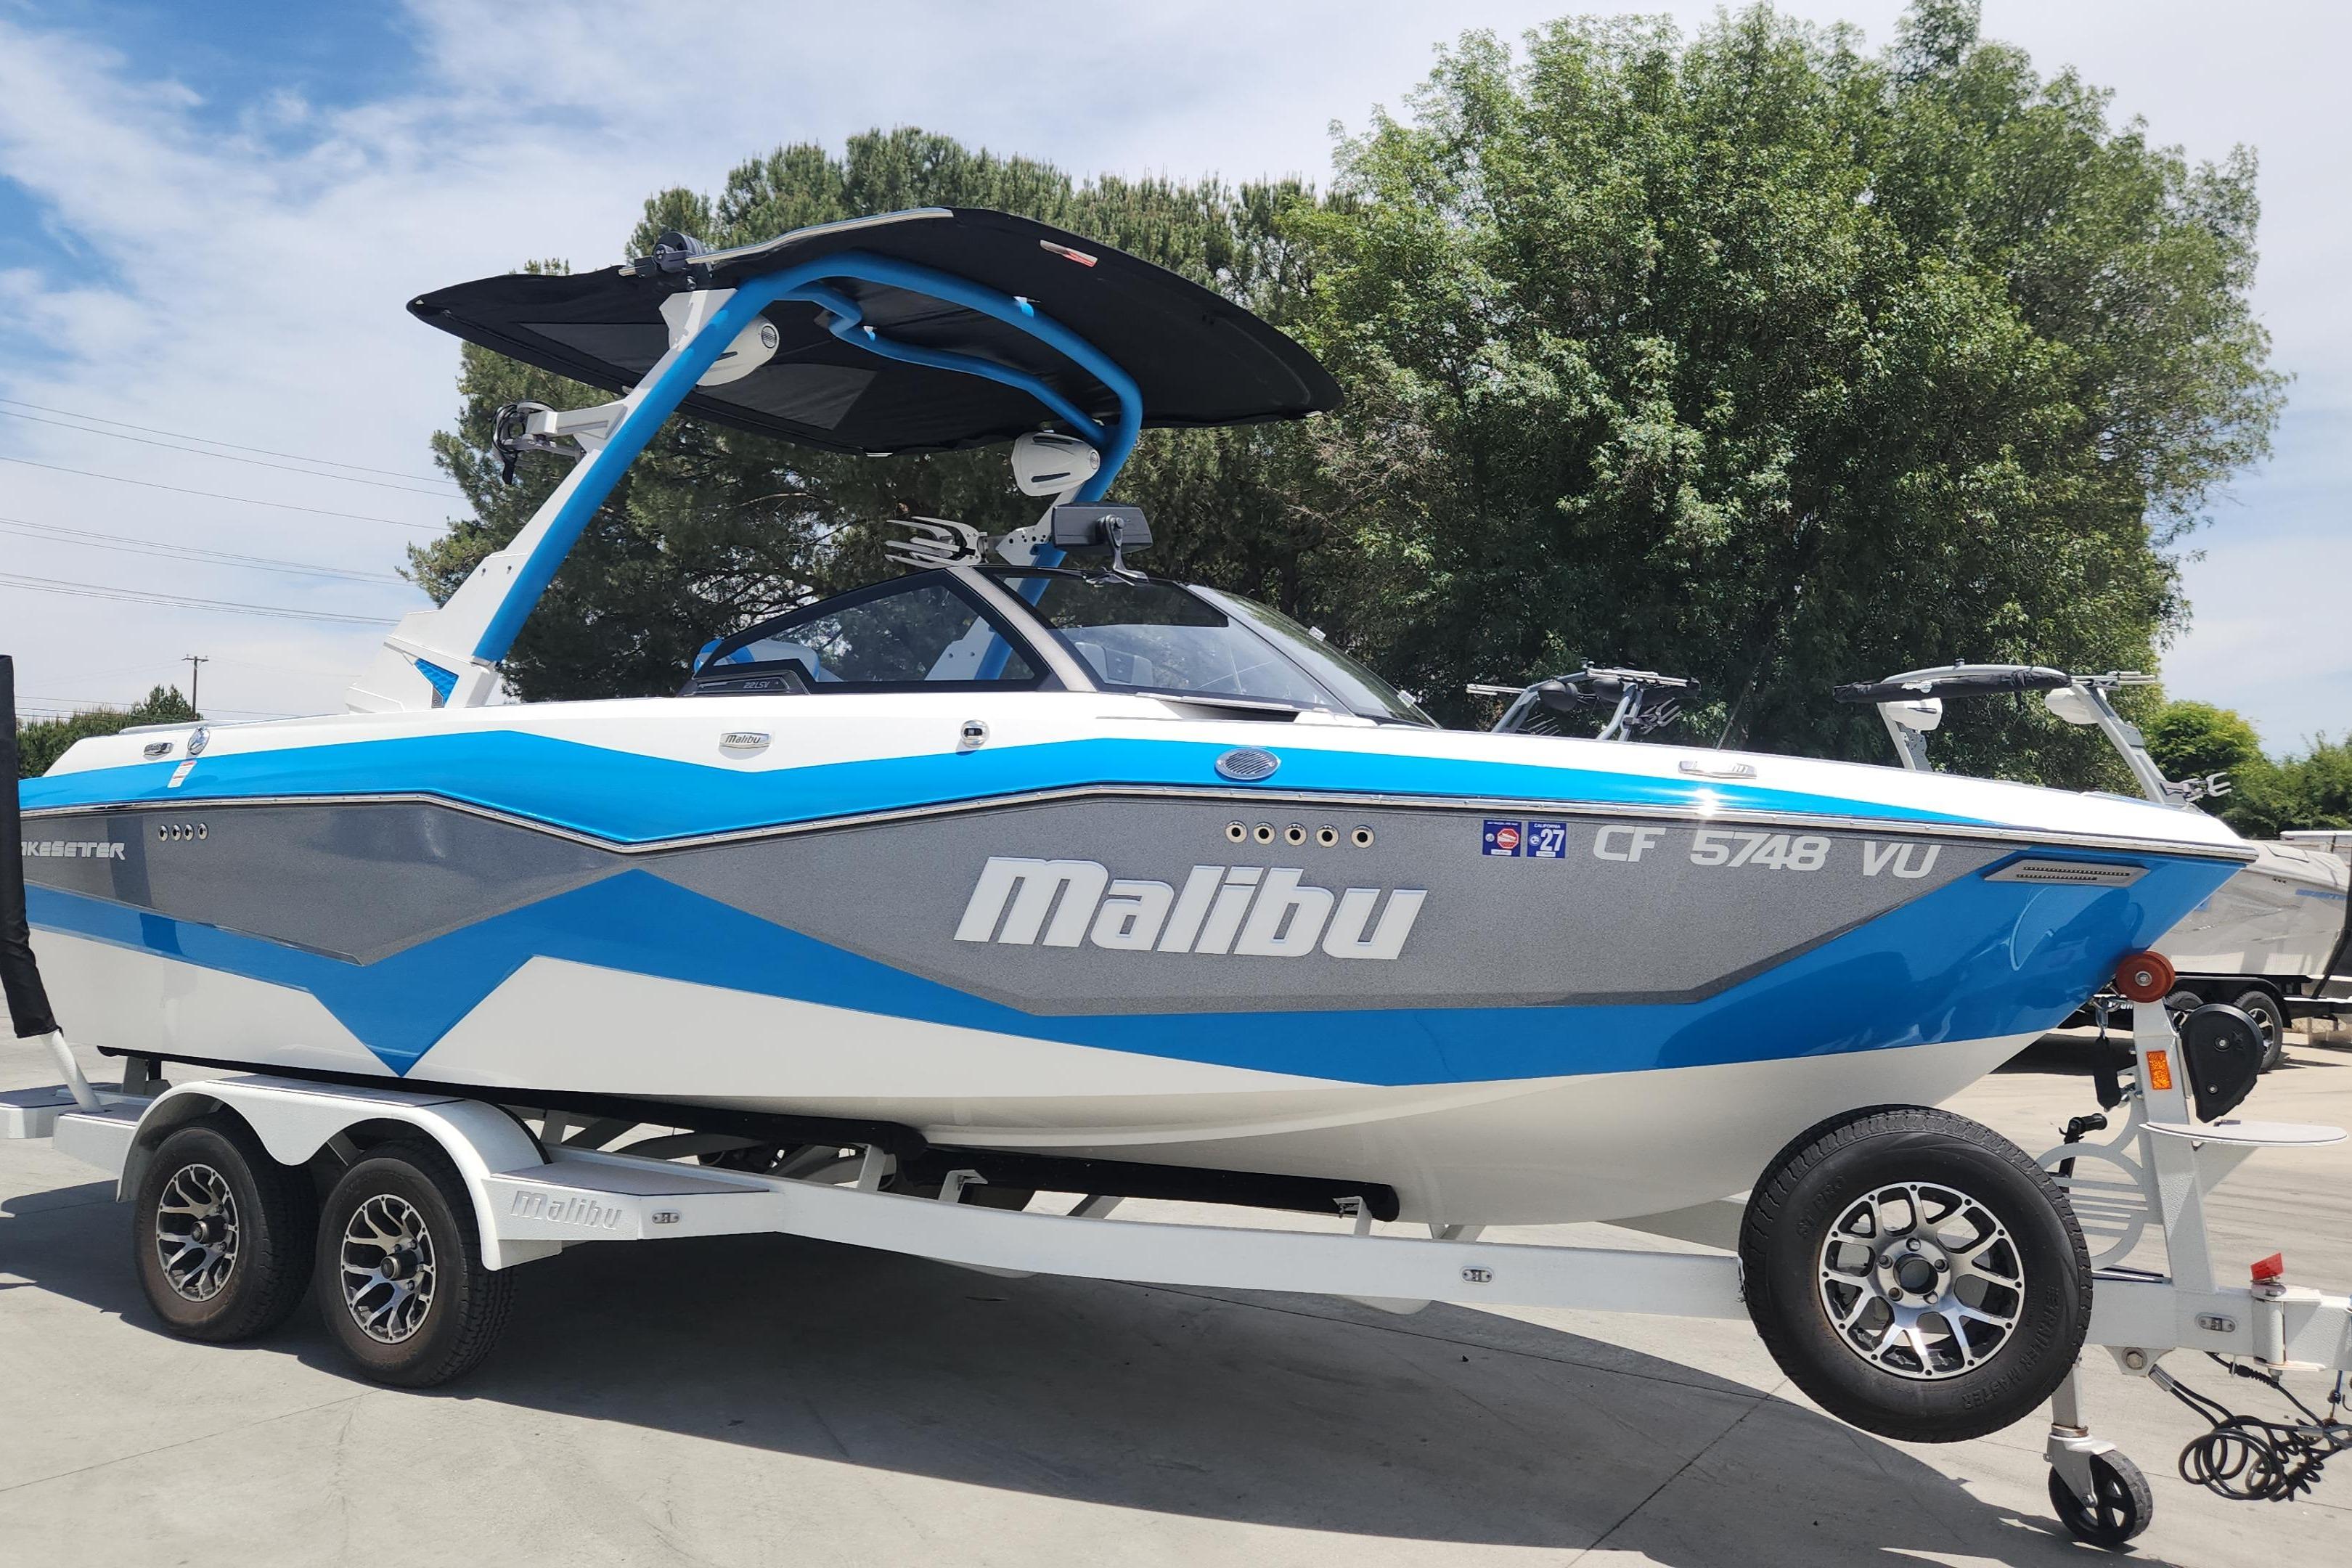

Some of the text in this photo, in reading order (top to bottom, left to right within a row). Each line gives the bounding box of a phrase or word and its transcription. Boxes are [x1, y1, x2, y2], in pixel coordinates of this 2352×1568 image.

[725, 735, 761, 743] Malibu
[1540, 828, 1564, 852] 27
[1593, 825, 1942, 878] CF 5748 VU
[953, 856, 1428, 960] Malibu
[510, 1190, 623, 1230] Malibu
